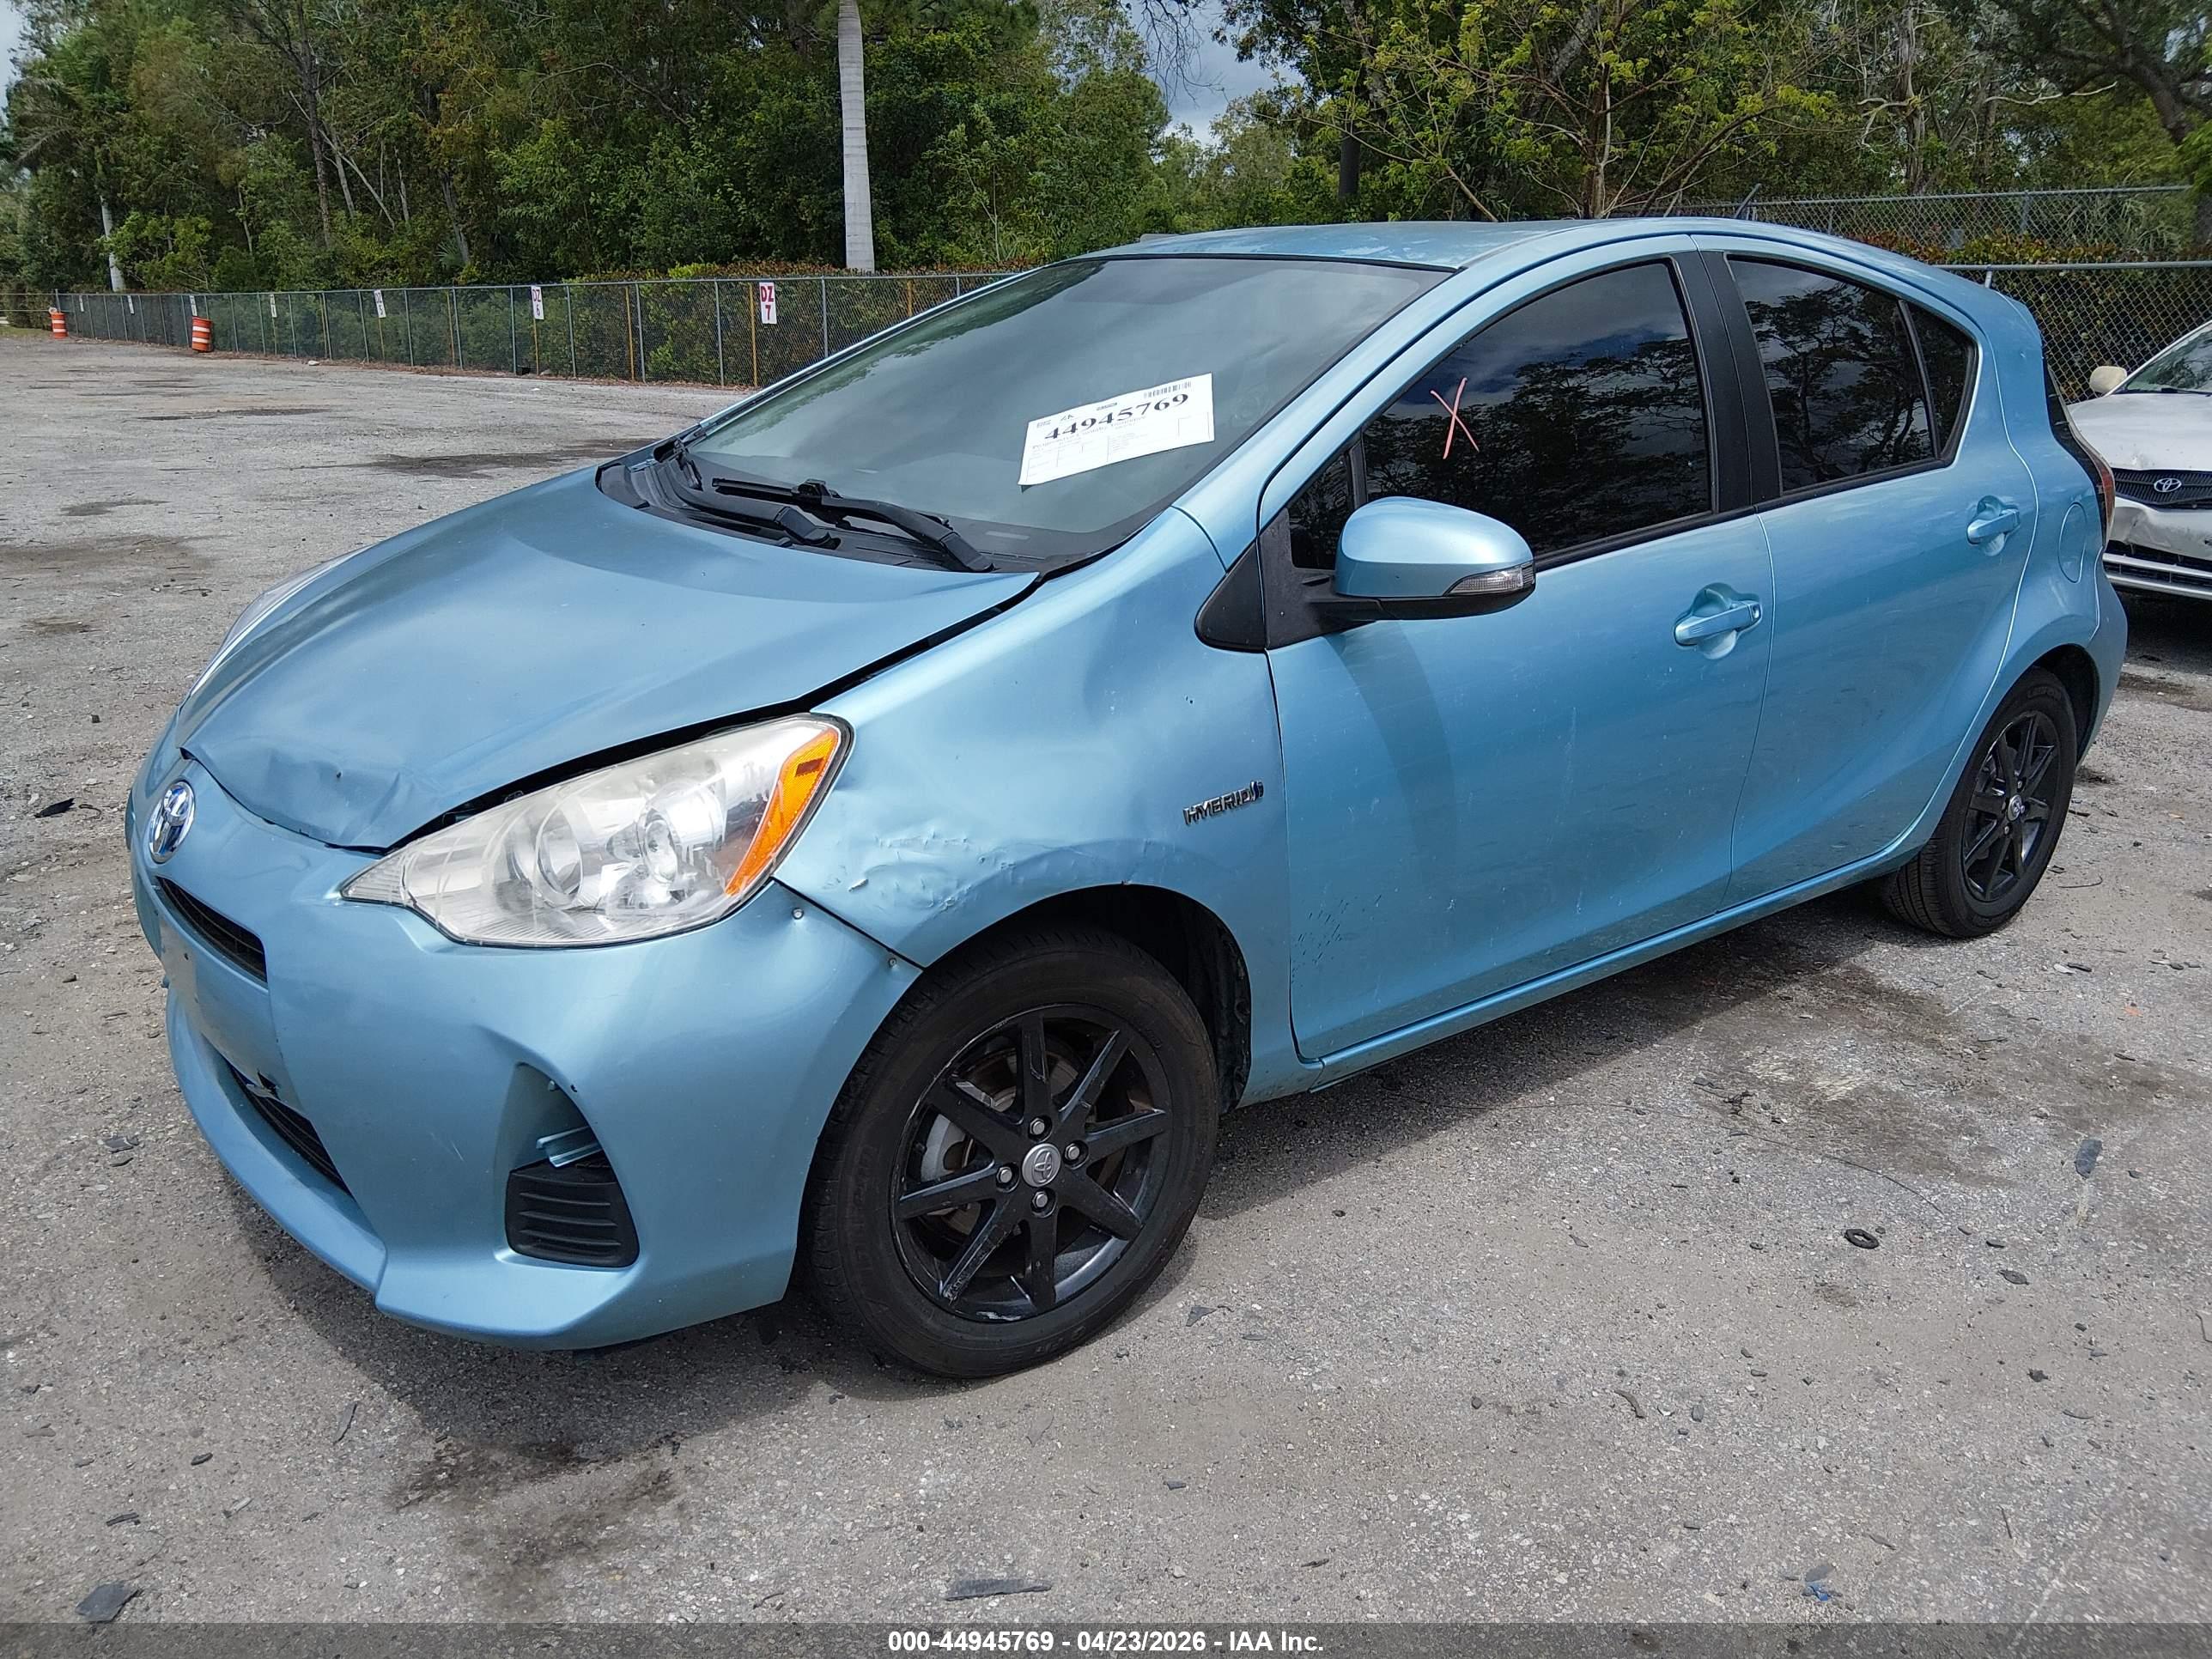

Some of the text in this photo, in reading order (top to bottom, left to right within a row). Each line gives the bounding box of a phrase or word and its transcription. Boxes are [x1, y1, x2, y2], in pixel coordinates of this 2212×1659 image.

[761, 286, 775, 302] DZ
[765, 304, 771, 320] 7
[1044, 393, 1189, 440] 44945769
[1182, 788, 1253, 825] HYBRID
